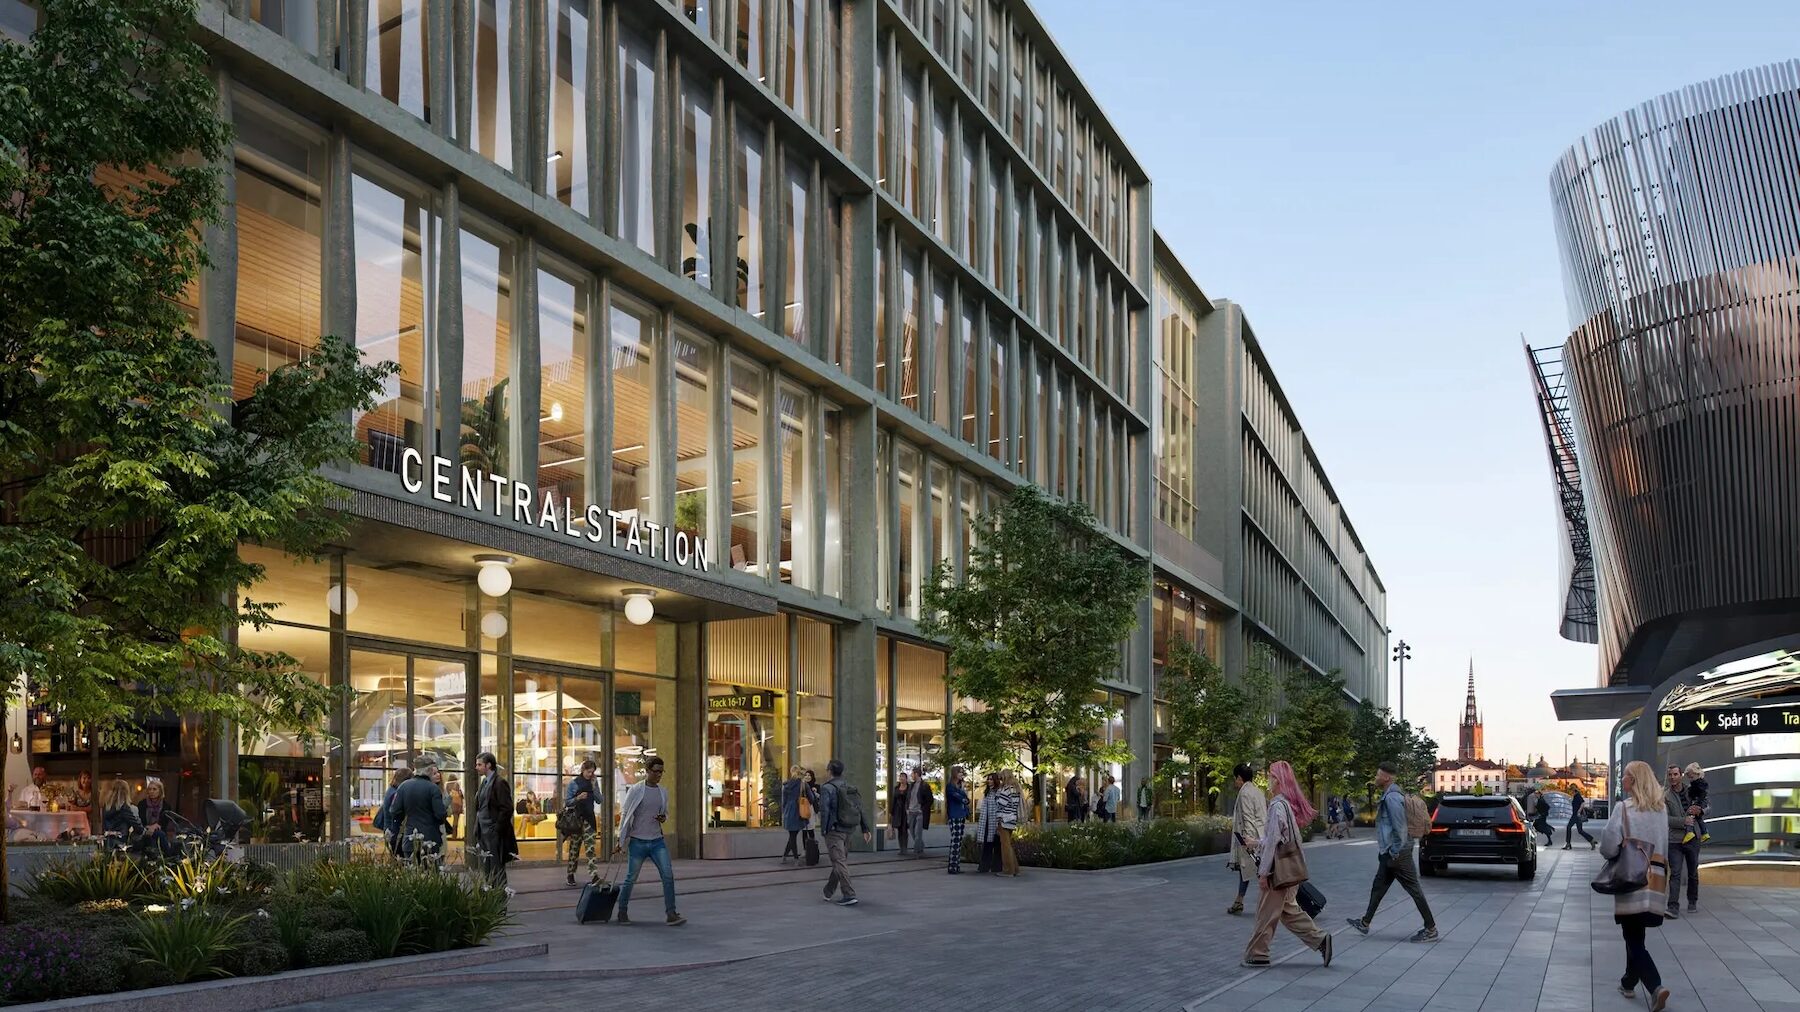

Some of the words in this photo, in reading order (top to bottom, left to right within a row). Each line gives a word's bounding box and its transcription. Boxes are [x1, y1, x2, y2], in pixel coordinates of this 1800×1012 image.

[401, 447, 709, 572] CENTRALSTATION
[709, 698, 727, 708] Track
[728, 697, 747, 707] 16-17
[1718, 712, 1743, 729] Spår
[1745, 713, 1759, 726] 18
